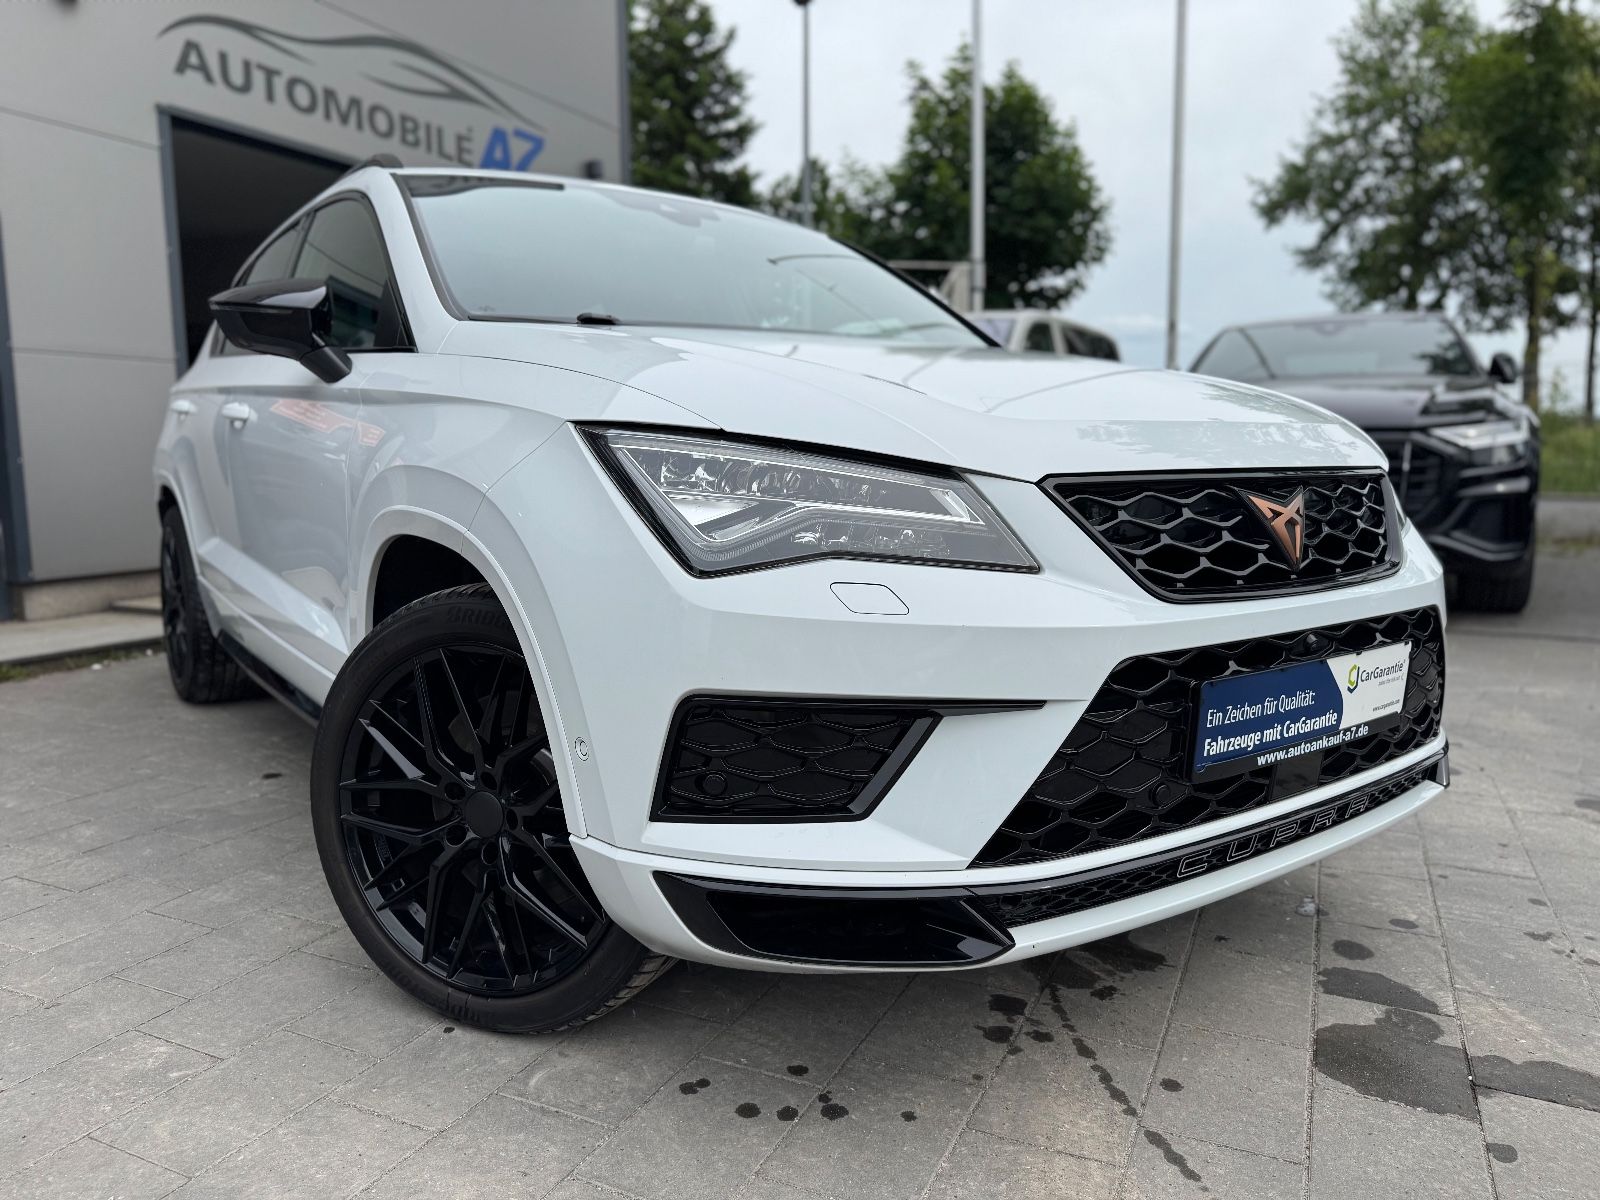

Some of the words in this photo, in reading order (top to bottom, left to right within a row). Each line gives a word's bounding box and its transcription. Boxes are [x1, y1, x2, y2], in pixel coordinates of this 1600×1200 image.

[479, 127, 545, 172] A7
[1360, 660, 1404, 683] CarGarantie
[1203, 736, 1261, 757] Fahrzeuge
[1263, 723, 1281, 743] mit
[1283, 709, 1338, 738] CarGarantie
[1206, 709, 1222, 728] Ein
[1224, 702, 1261, 725] Zeichen
[1263, 697, 1278, 716] für
[1257, 724, 1369, 766] www.autoankauf-a7.de
[1176, 793, 1371, 878] CUPRA
